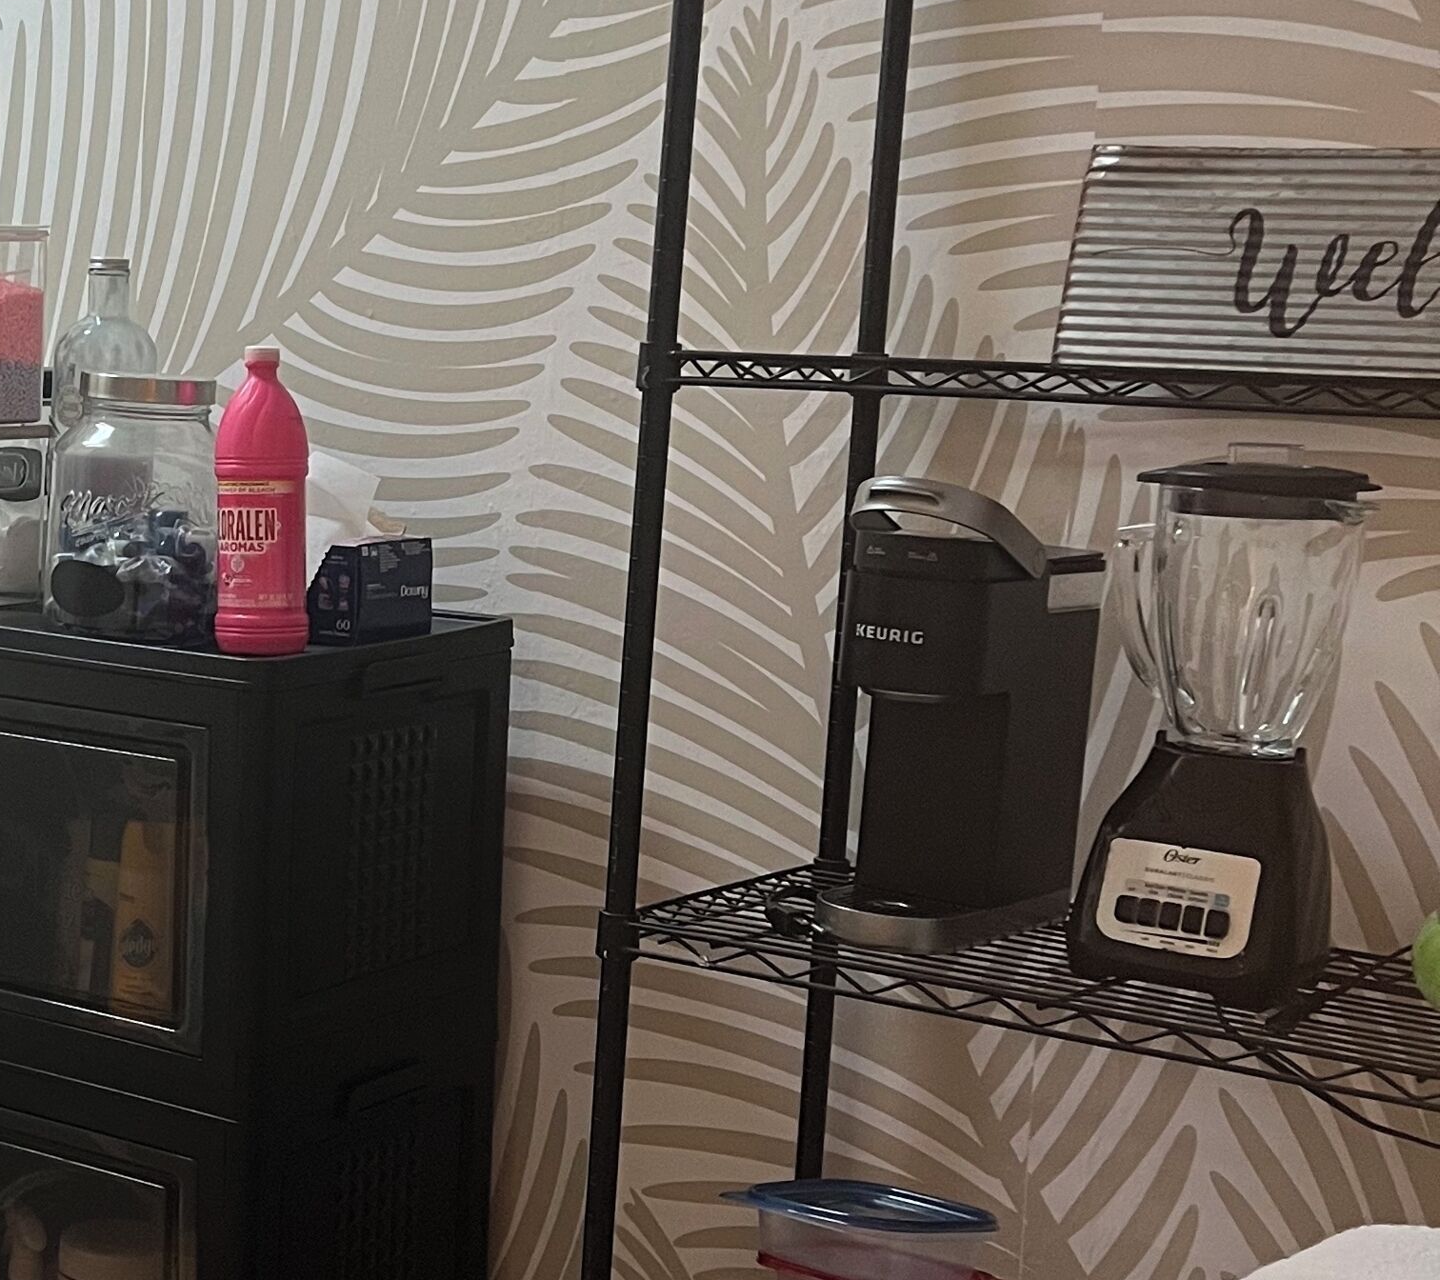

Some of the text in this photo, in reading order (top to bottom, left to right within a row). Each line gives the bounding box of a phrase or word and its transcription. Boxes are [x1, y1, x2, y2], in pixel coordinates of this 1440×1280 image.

[219, 541, 265, 553] AROMAS
[400, 584, 430, 599] Downy
[336, 619, 351, 631] 60
[855, 623, 924, 645] KEURIG
[1163, 848, 1202, 866] Oster
